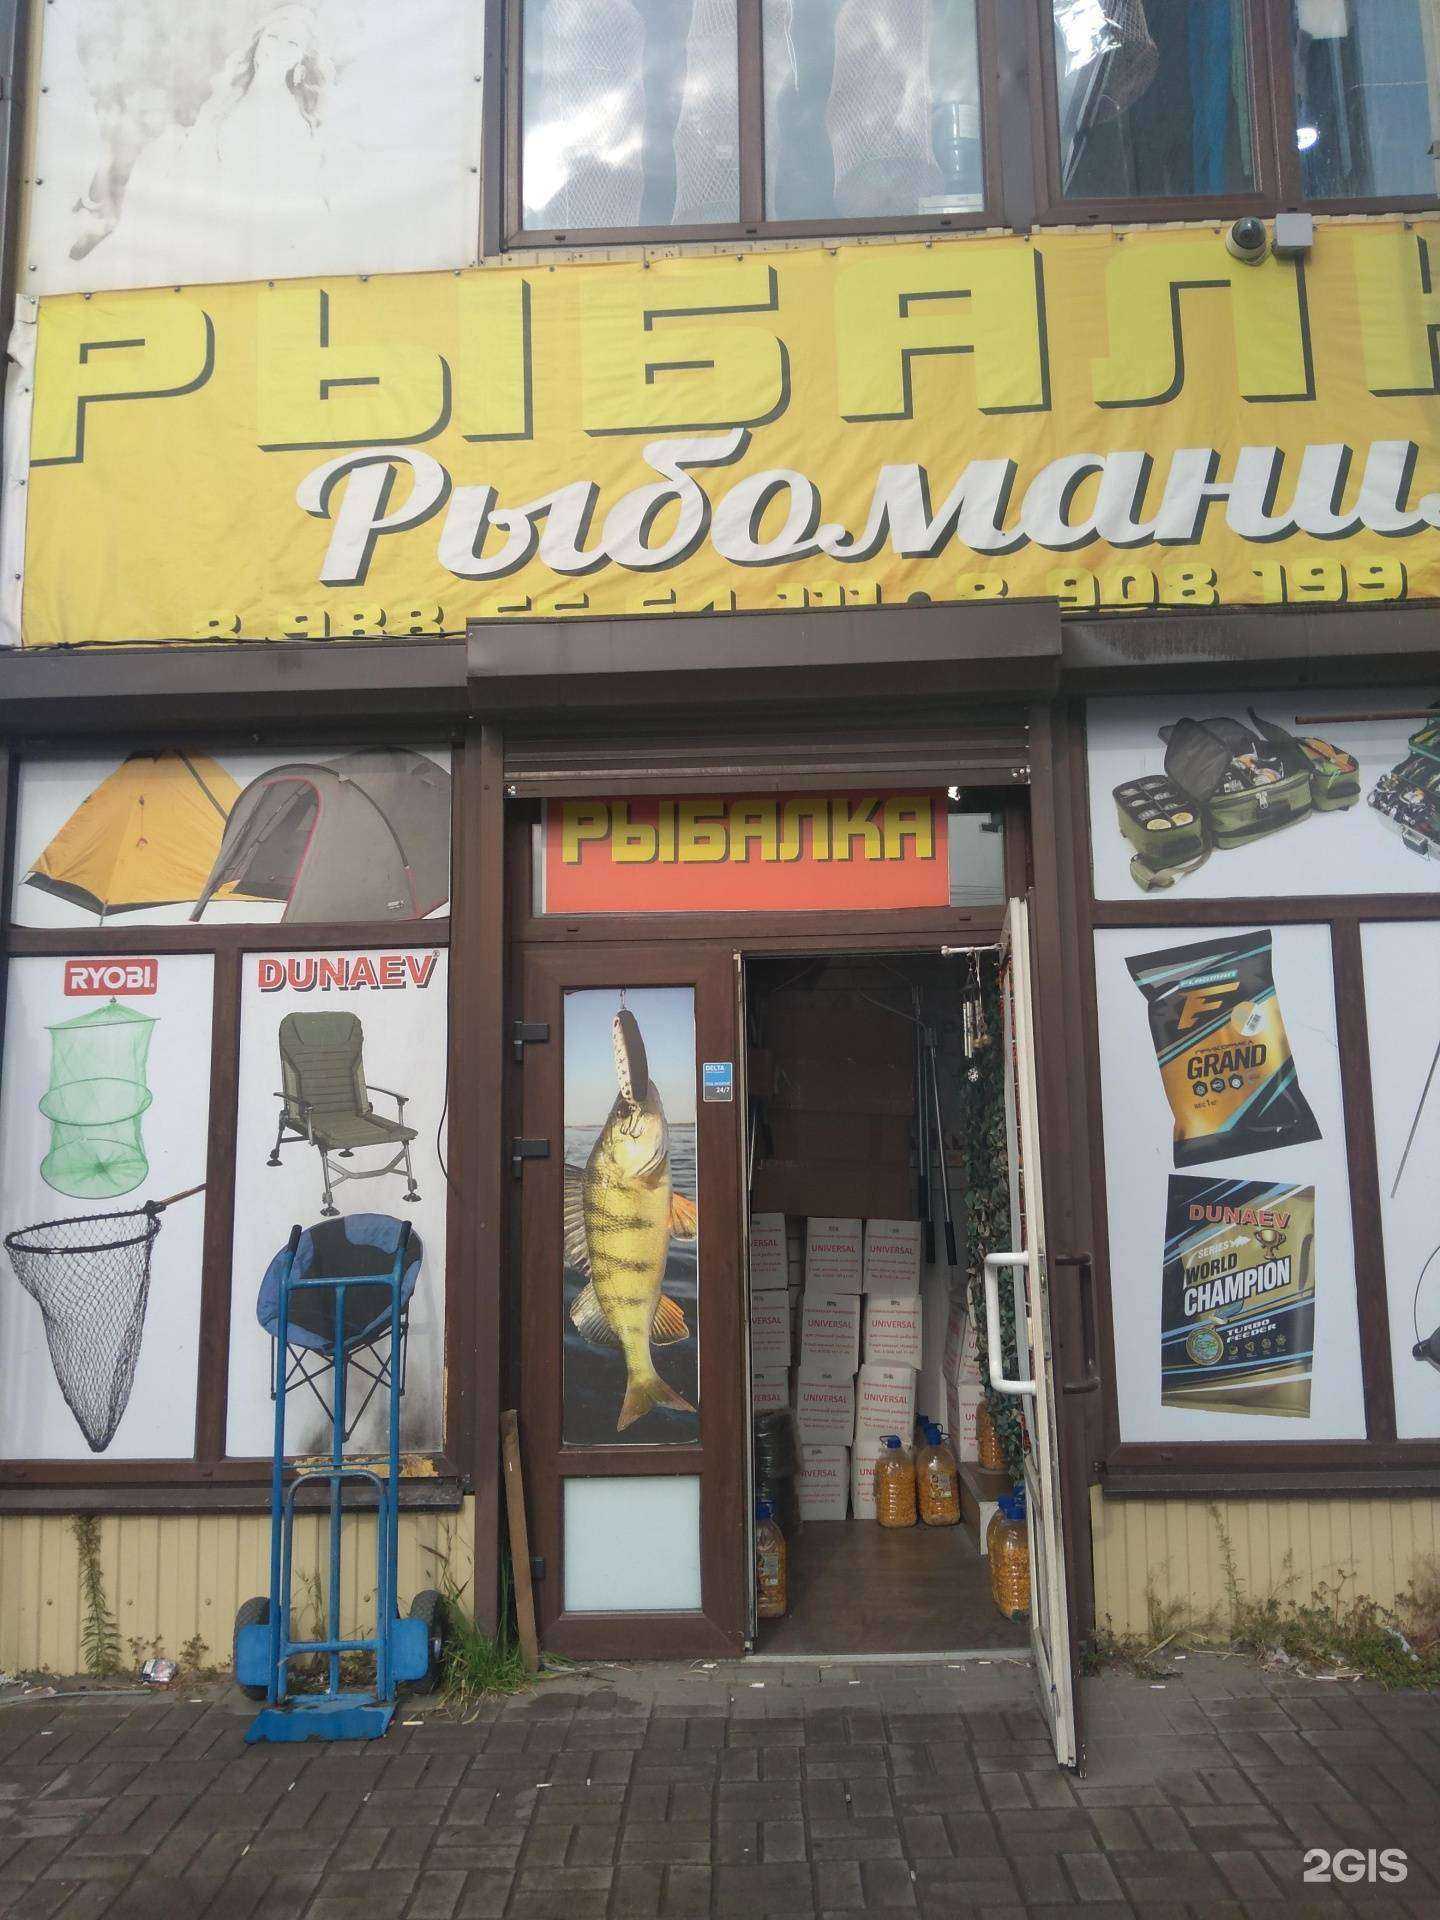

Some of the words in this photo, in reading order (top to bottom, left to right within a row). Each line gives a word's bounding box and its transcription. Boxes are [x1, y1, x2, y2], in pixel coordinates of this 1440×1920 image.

[296, 427, 1440, 586] Рыбомани
[1047, 563, 1220, 608] 908
[1252, 557, 1409, 604] 199
[562, 796, 937, 864] РЫБАЛКА
[70, 966, 152, 989] RYOBI
[257, 954, 438, 992] DUNAEV
[1187, 1044, 1267, 1080] GRAND
[1188, 1204, 1291, 1229] DUNAEV
[811, 1244, 856, 1253] UNIVERSAL
[870, 1245, 913, 1255] UNIVERSAL
[1198, 1241, 1230, 1258] SERIES
[1185, 1253, 1238, 1284] WORLD
[1184, 1256, 1291, 1317] CHAMPION
[808, 1320, 854, 1329] UNIVERSAL
[872, 1319, 917, 1329] UNIVERSAL
[1226, 1323, 1277, 1343] FEEDER
[1227, 1319, 1270, 1336] TURBO
[803, 1393, 848, 1404] UNIVERSAL
[864, 1393, 908, 1404] UNIVERSAL
[800, 1469, 837, 1478] IVERSAL
